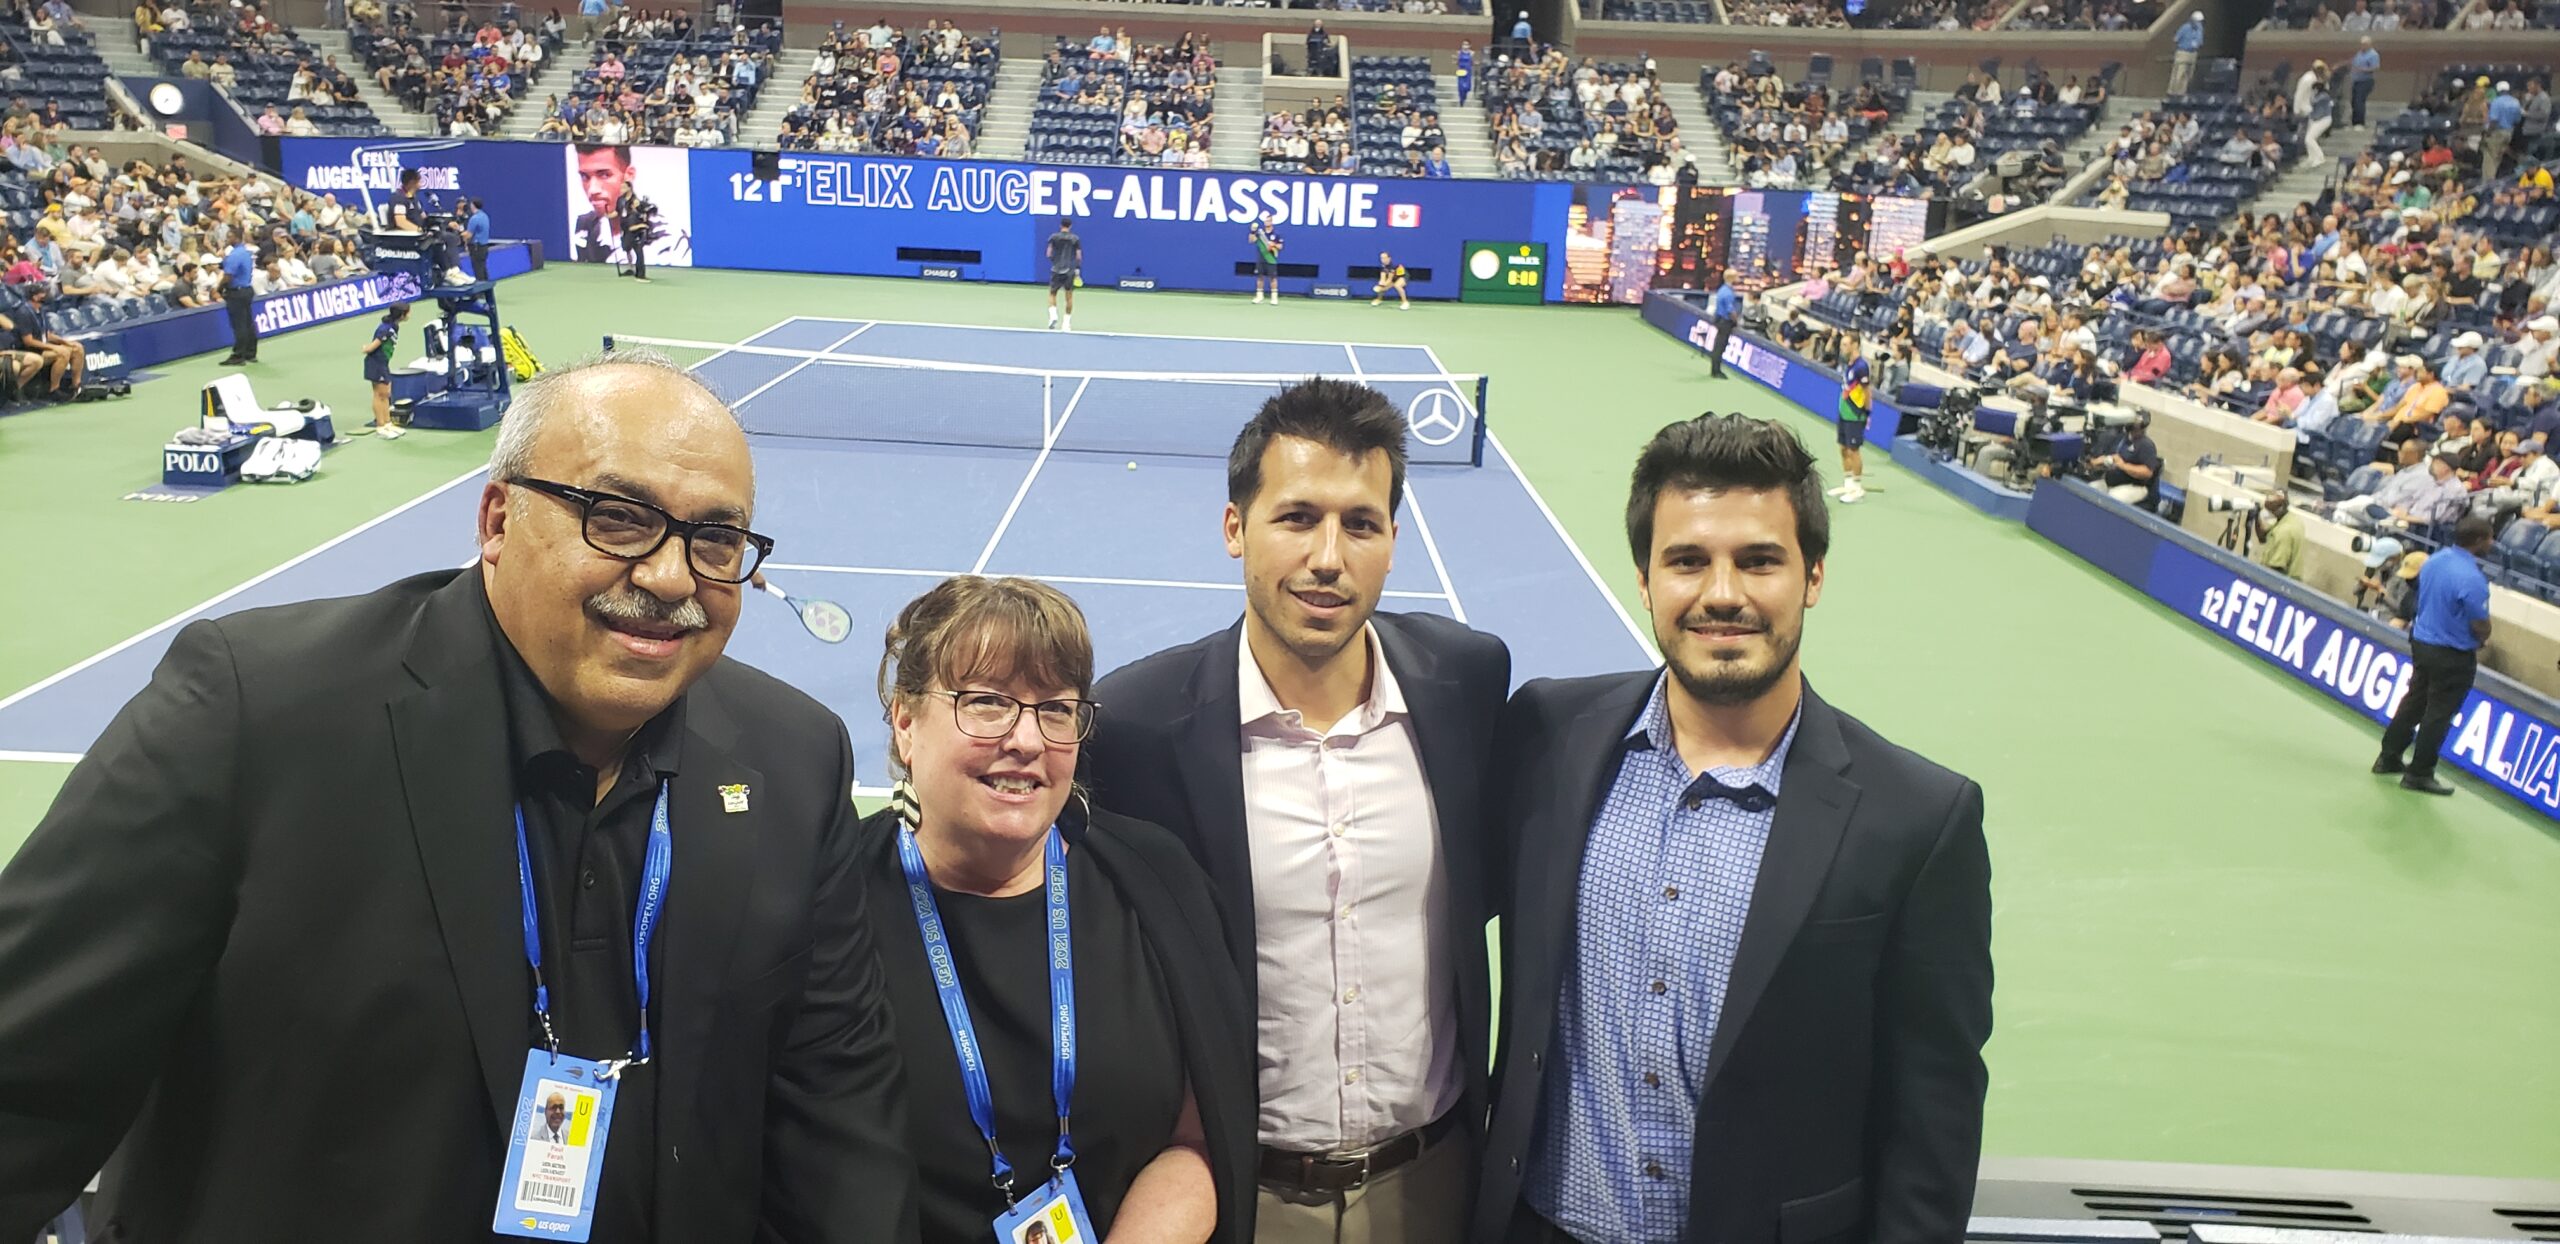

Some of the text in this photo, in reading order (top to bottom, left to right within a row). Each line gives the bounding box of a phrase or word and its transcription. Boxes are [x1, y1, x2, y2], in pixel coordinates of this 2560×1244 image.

[362, 150, 401, 167] FELIX
[729, 158, 1380, 228] 12 FELIX AUGER-ALIASSIME
[255, 313, 269, 333] 12
[265, 293, 313, 328] FELIX
[85, 350, 122, 372] Wilson
[165, 452, 219, 473] POLO
[2199, 586, 2229, 624] 12
[2220, 579, 2317, 669] FELIX
[638, 876, 661, 945] USOPEN.ORG
[1050, 865, 1070, 970] 2021 US OPEN
[911, 881, 954, 989] 2021 US OPEN
[1059, 1004, 1070, 1060] USOPEN.ORG
[579, 1102, 589, 1116] U
[537, 1221, 571, 1233] us open
[1054, 1209, 1064, 1221] U
